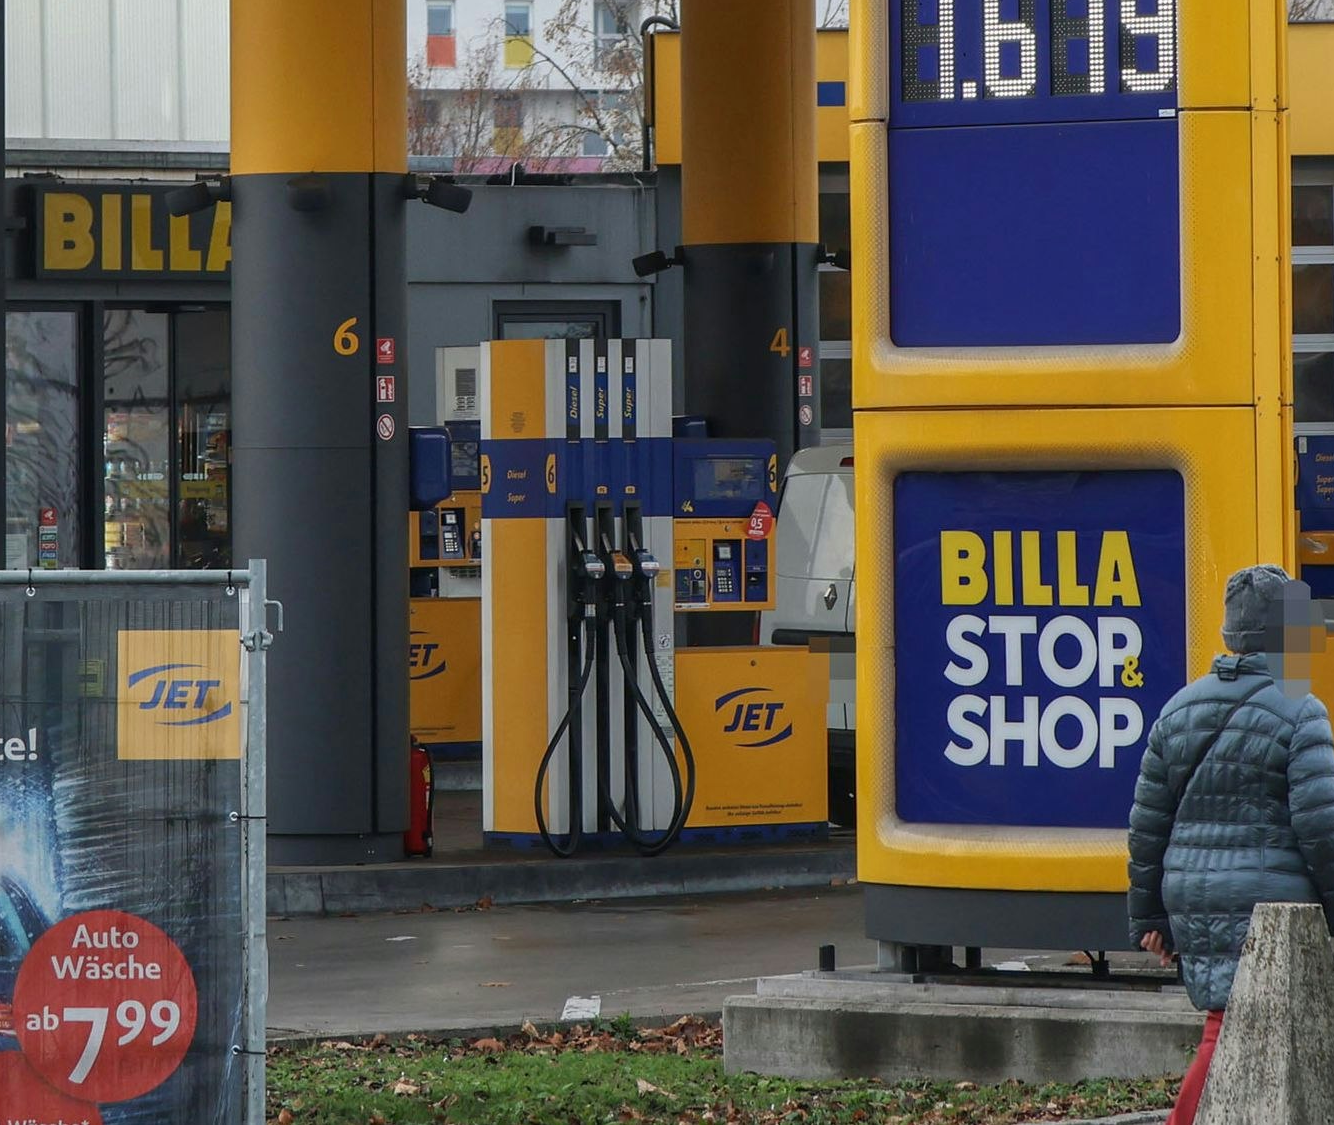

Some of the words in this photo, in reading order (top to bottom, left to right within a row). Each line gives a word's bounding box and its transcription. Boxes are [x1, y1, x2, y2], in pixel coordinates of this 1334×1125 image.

[333, 316, 359, 356] 6
[770, 327, 791, 357] 4
[569, 386, 579, 419] Diesel
[596, 387, 607, 419] Super
[624, 387, 635, 419] Super
[507, 470, 527, 479] Diesel
[547, 464, 555, 484] 6
[507, 493, 526, 503] Super
[940, 530, 1142, 607] BILLA
[943, 614, 1143, 688] STOP
[1121, 655, 1144, 688] &
[138, 680, 221, 710] JET
[723, 702, 785, 733] JET
[943, 694, 1144, 769] SHOP
[71, 924, 140, 950] Auto
[51, 954, 162, 980] Wäsche
[26, 1005, 60, 1031] ab
